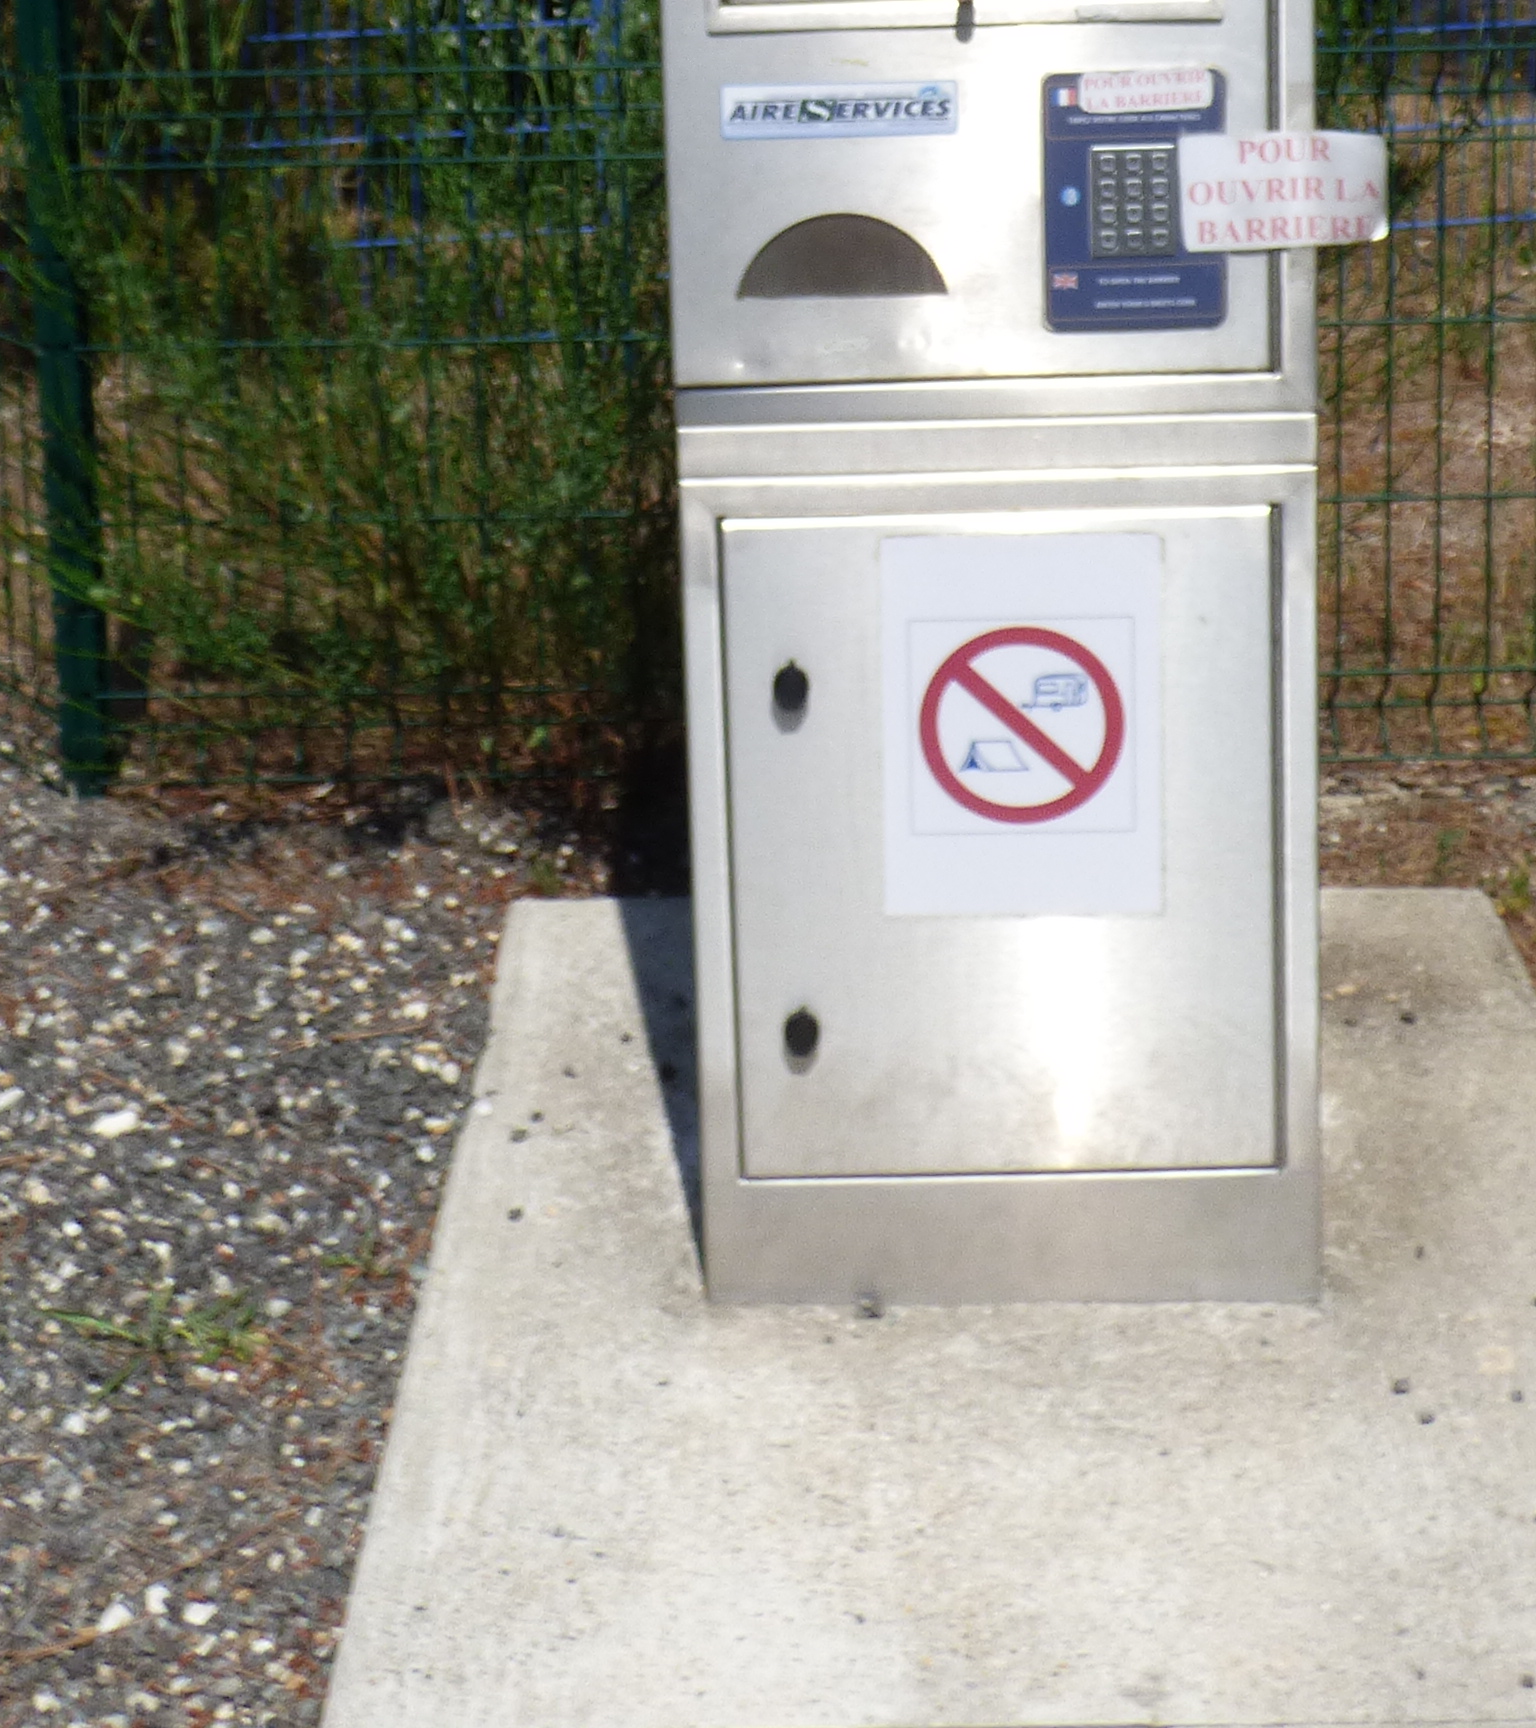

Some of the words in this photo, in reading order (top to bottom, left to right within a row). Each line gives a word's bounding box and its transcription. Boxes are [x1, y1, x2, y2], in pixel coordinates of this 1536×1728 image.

[1084, 75, 1133, 91] POUR
[1114, 90, 1204, 109] BARRIERE
[1238, 137, 1331, 164] POUR
[1188, 176, 1325, 206] OUVRIR
[1336, 178, 1381, 202] LA
[1197, 214, 1373, 245] BARRIERE
